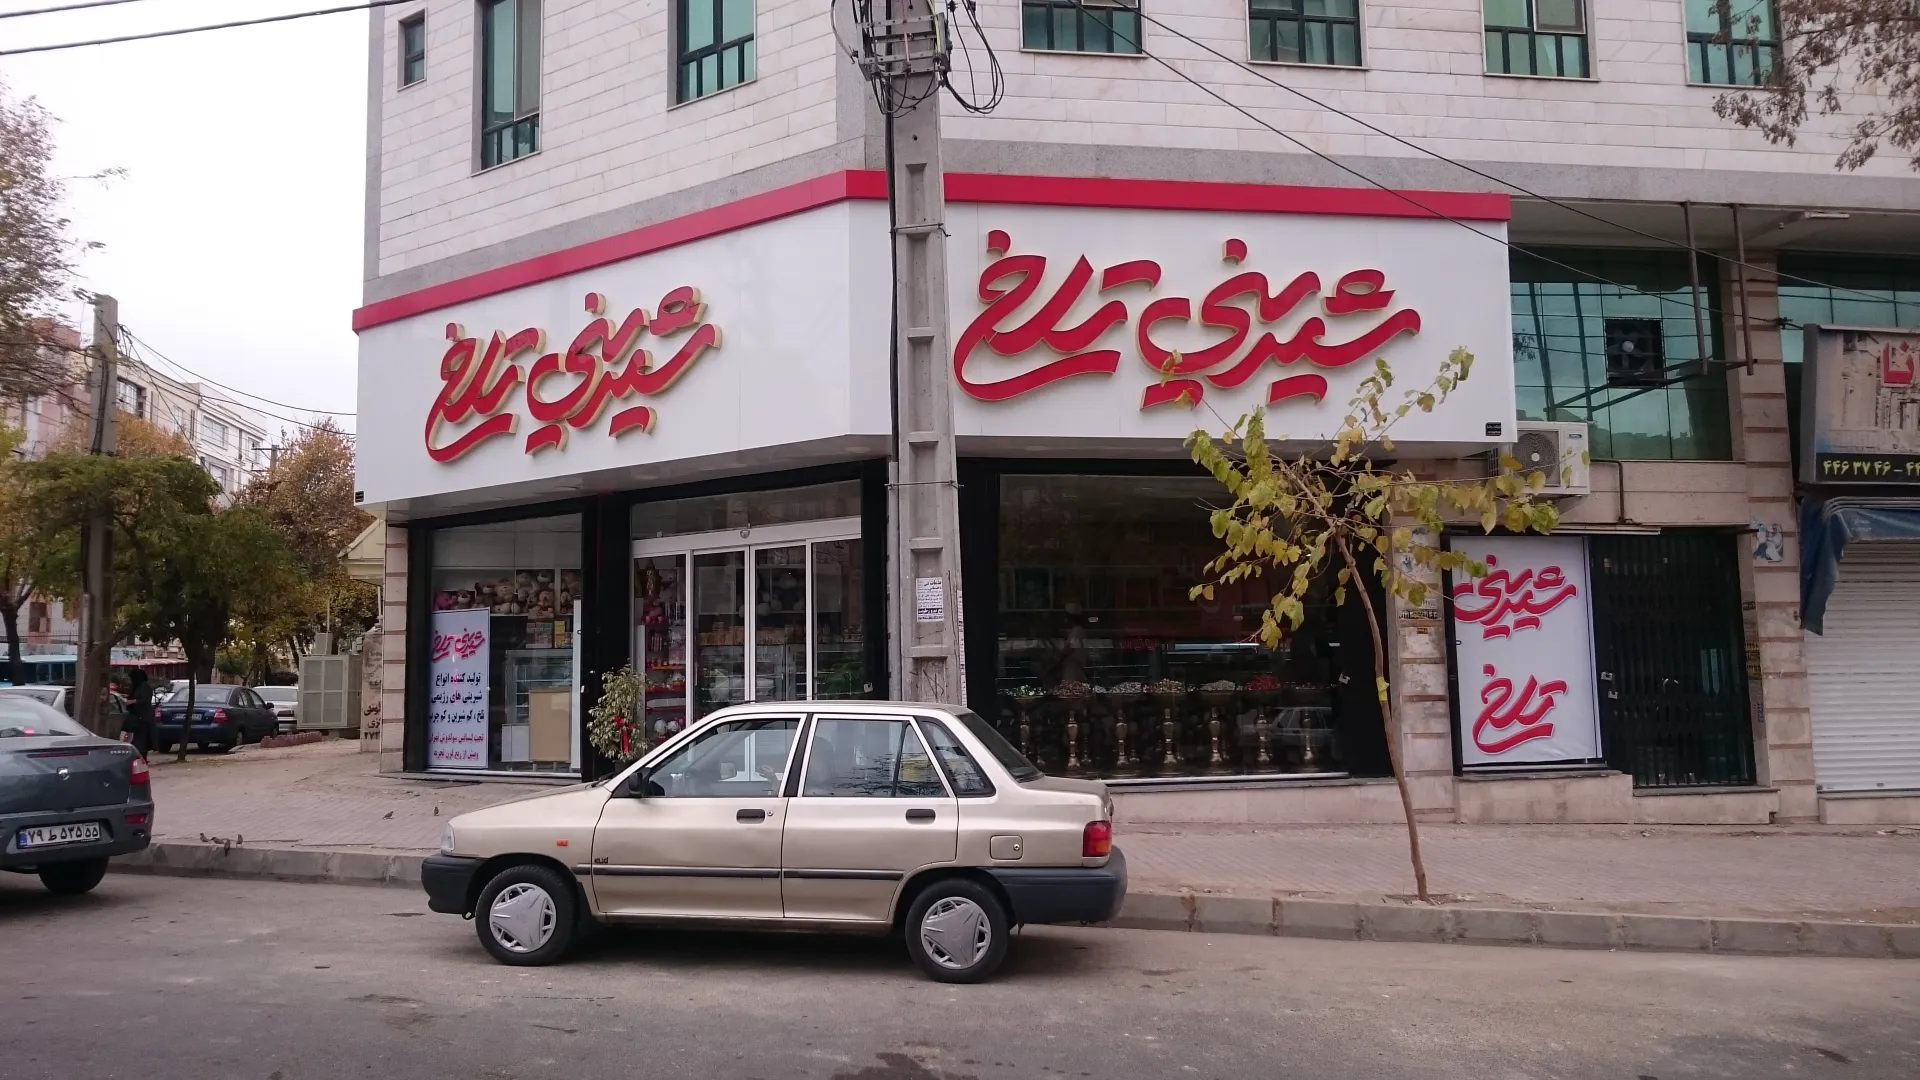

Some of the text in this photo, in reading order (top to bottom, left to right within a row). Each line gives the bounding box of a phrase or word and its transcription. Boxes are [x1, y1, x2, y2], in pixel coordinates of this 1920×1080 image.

[953, 229, 1421, 411] شیرینی تلخ
[424, 285, 723, 464] شیرینی تلخ
[1453, 554, 1577, 640] شیرینی
[431, 627, 486, 663] شیرینی تلخ
[435, 672, 450, 687] انواع
[466, 672, 481, 686] تولید
[1472, 663, 1568, 755] تلخ
[28, 829, 45, 843] ۷۹
[60, 825, 83, 840] ۵۳۵
